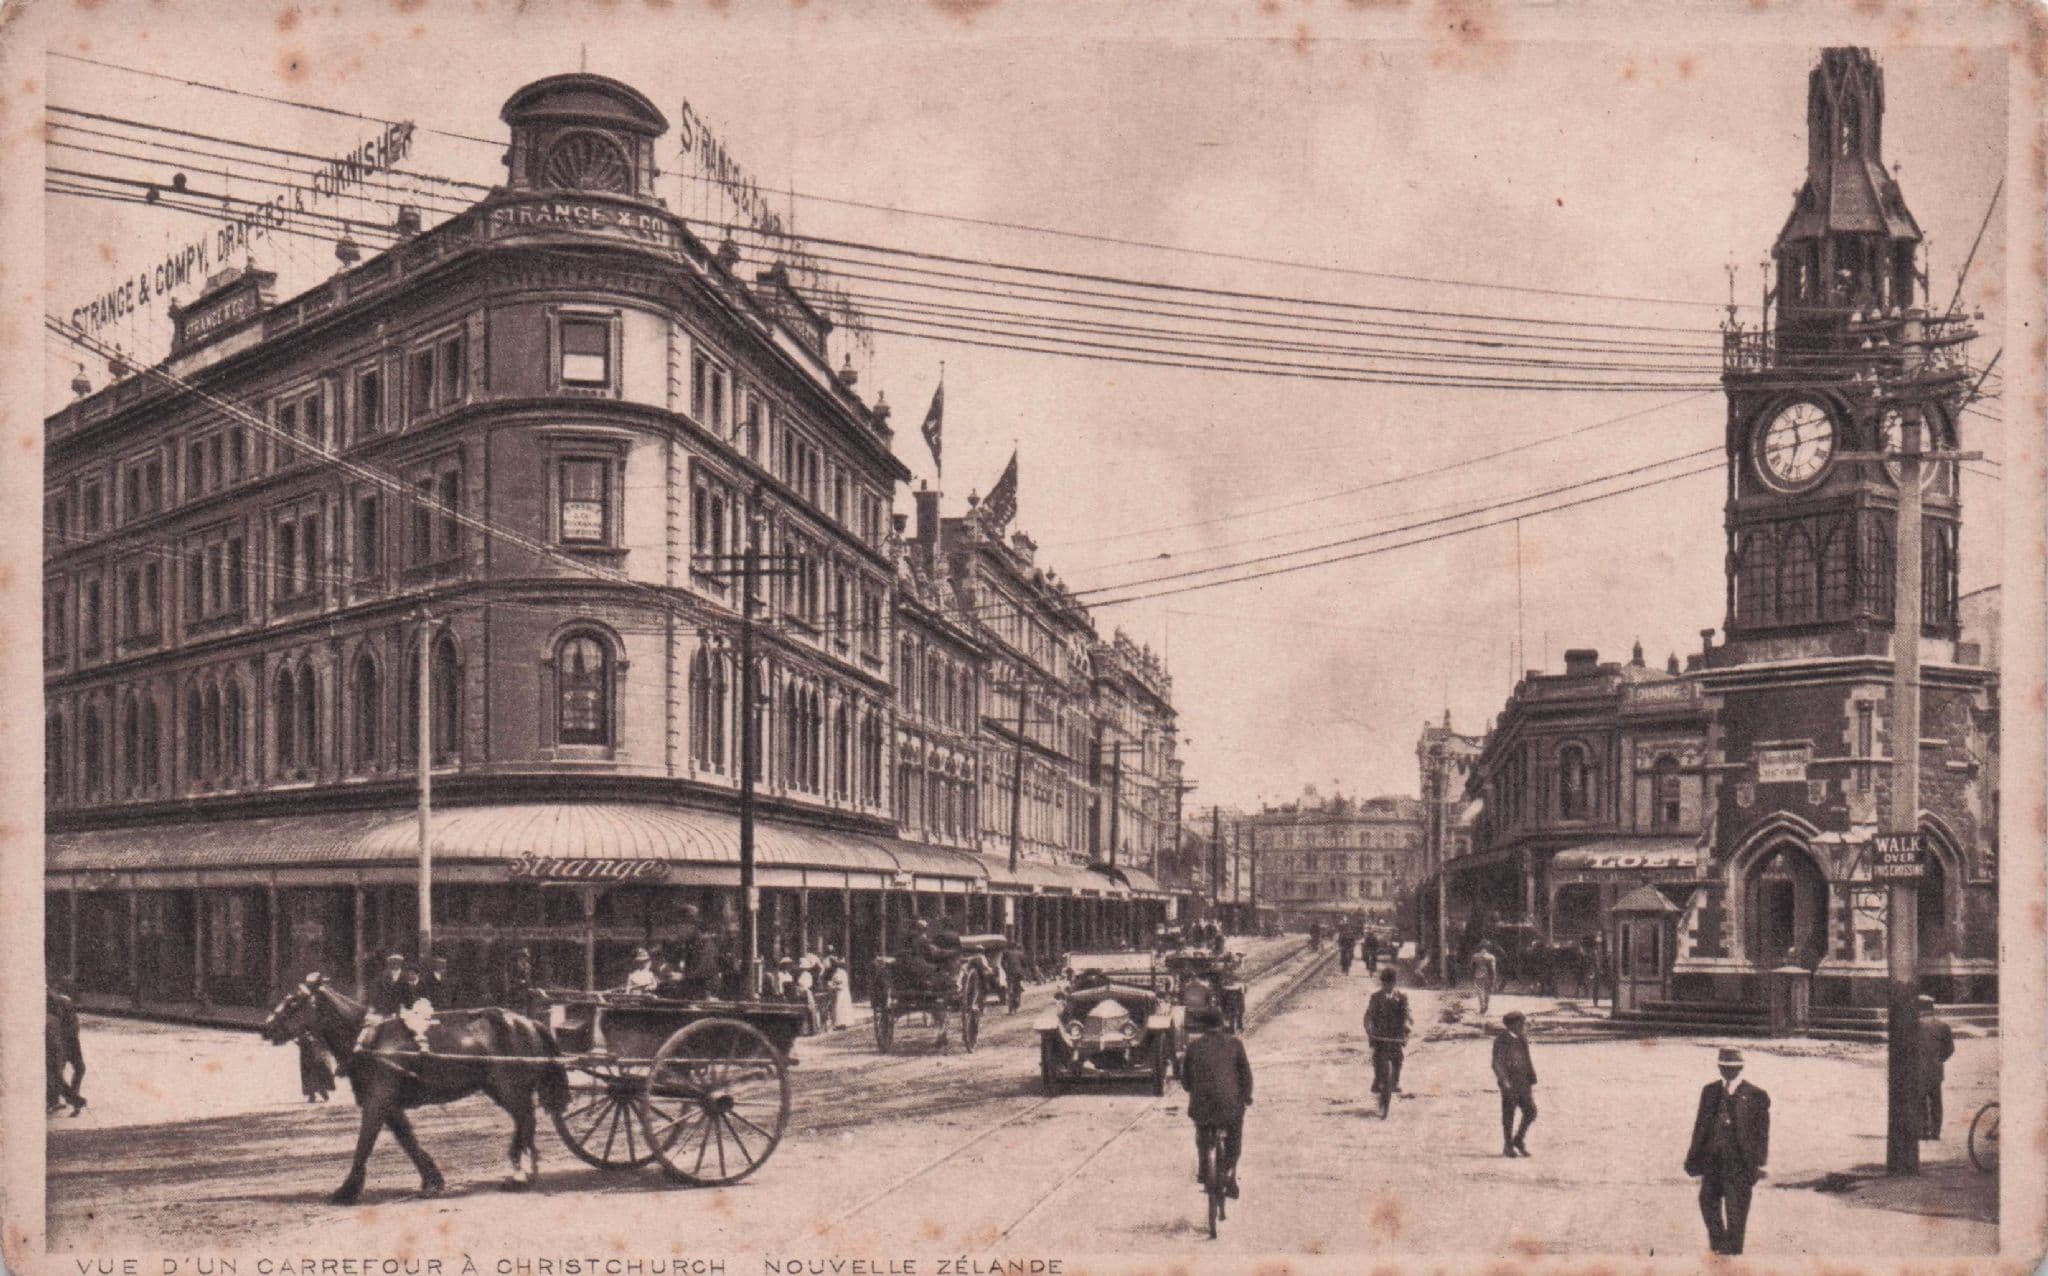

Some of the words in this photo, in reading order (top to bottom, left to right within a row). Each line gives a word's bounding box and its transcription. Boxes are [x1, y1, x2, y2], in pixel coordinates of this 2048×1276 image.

[490, 203, 606, 230] STRANGE
[71, 279, 134, 335] STRANGE
[139, 273, 150, 305] &
[1875, 836, 1921, 852] WALK
[1883, 853, 1915, 863] OVER
